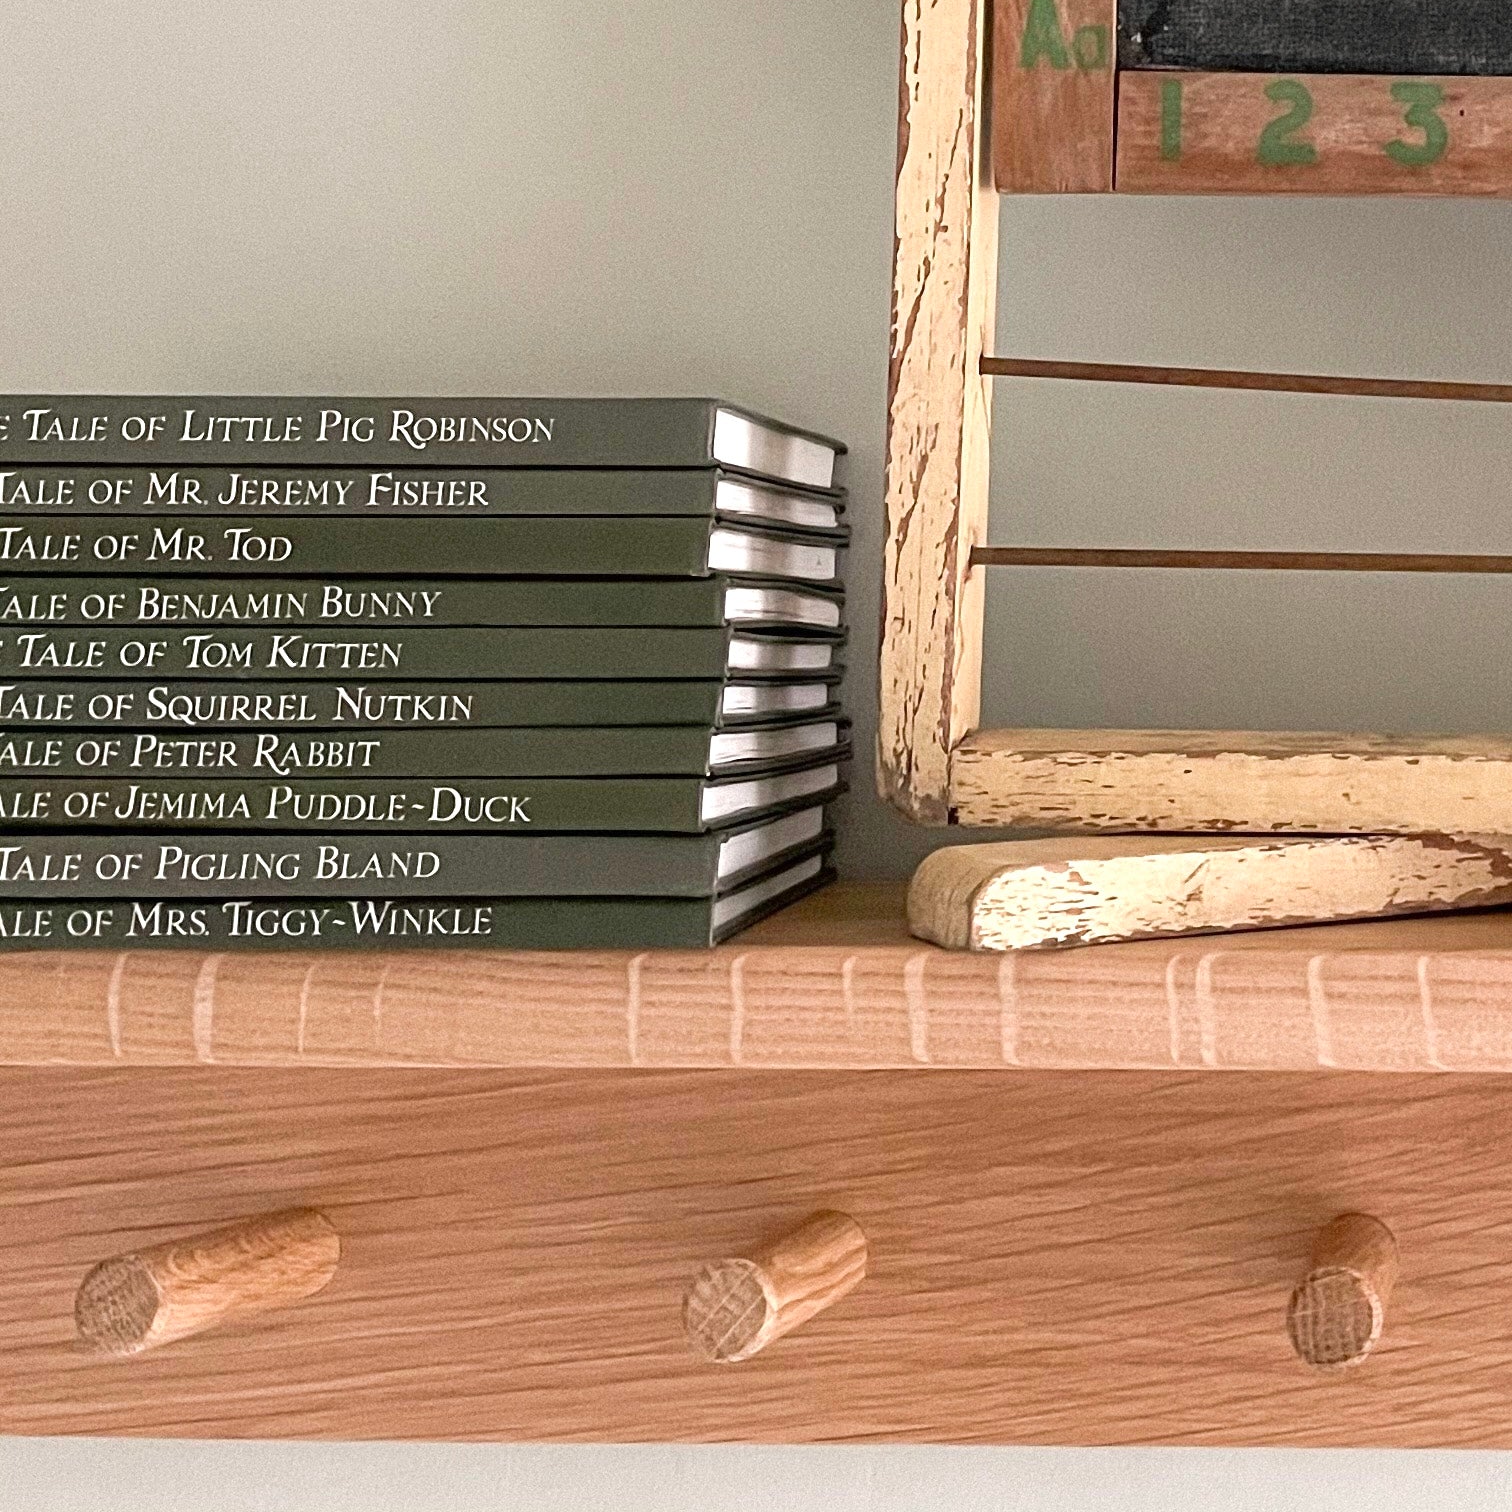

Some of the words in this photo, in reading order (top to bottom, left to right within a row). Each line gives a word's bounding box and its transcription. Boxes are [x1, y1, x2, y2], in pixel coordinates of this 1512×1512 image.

[1160, 78, 1184, 164] 1
[1256, 78, 1318, 166] 2
[1385, 81, 1449, 168] 3
[0, 587, 67, 620] ALE
[0, 732, 62, 767] ALE
